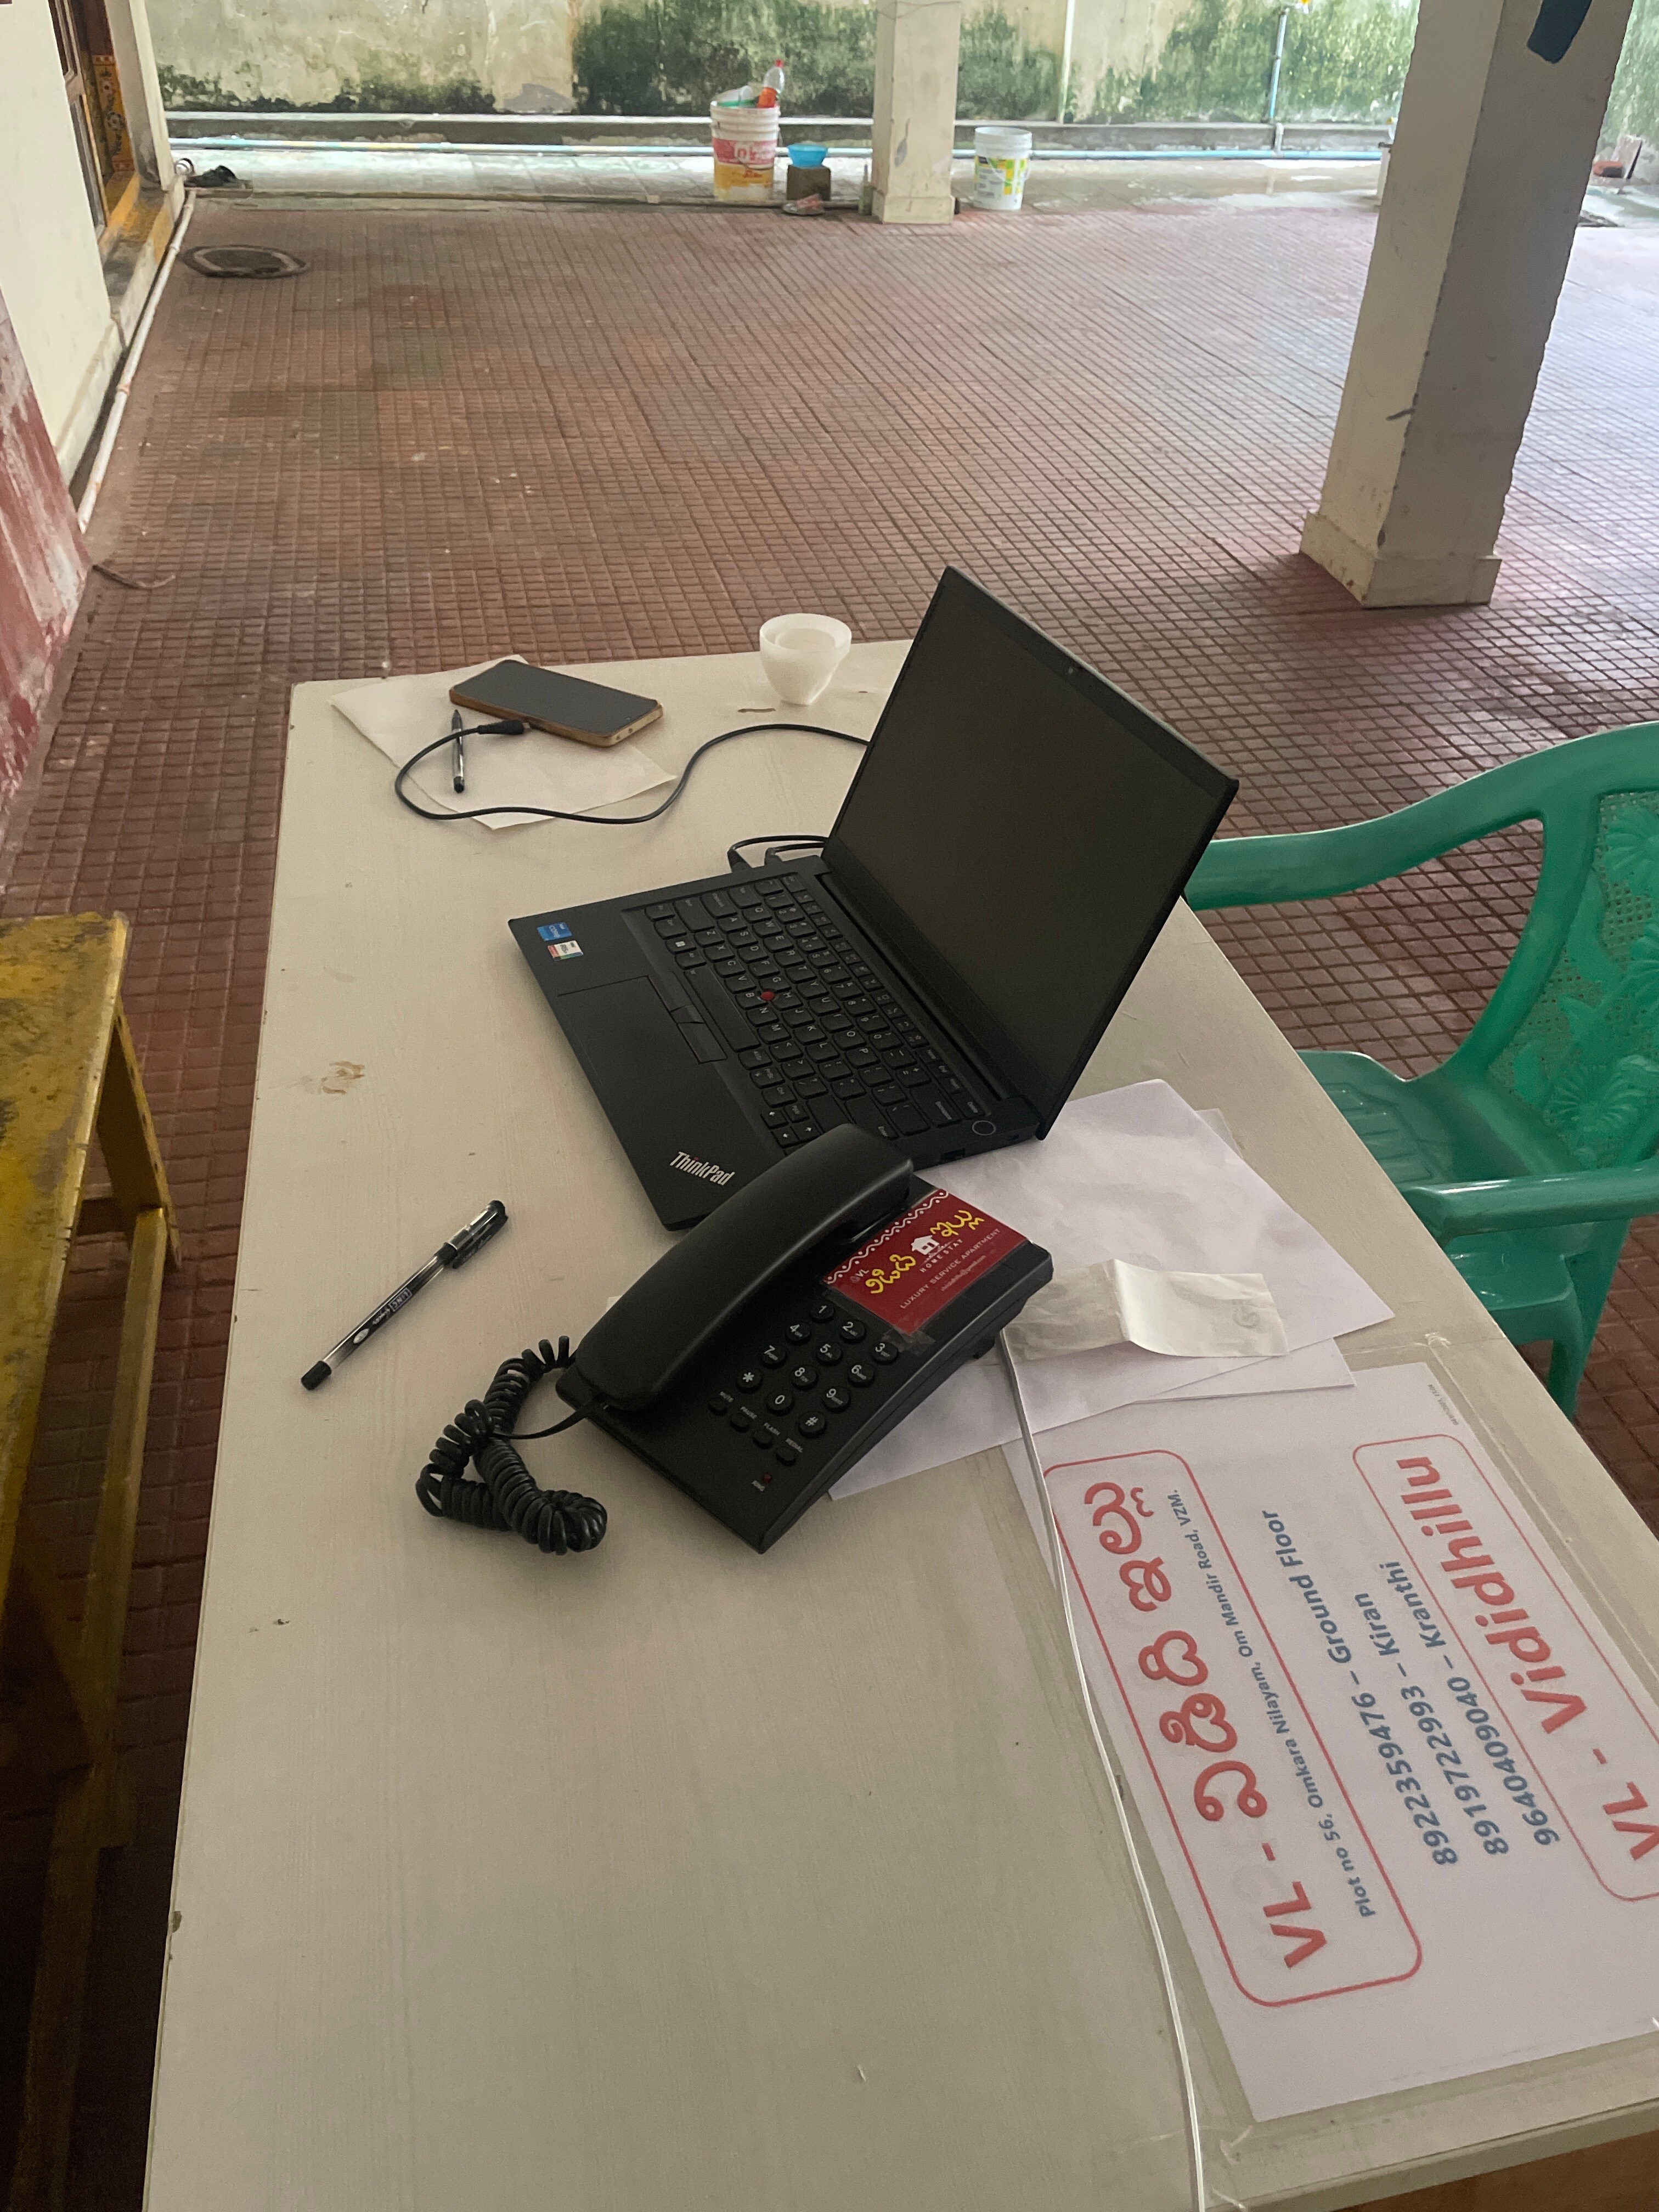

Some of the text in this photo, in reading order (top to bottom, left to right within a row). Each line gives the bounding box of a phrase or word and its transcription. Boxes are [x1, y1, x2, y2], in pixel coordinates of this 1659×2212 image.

[669, 1151, 736, 1186] ThinkPad
[855, 1268, 870, 1278] VL
[865, 1254, 917, 1294] విడిది
[929, 1210, 985, 1237] ఇల్లు
[899, 1283, 930, 1309] LUXURY
[930, 1259, 961, 1284] SERVICE
[960, 1227, 1001, 1260] APARTMENT
[919, 1254, 944, 1273] HOME
[944, 1238, 963, 1255] STAY
[789, 1324, 862, 1374] 4 5 6
[818, 1305, 885, 1352] 1 2 3
[763, 1345, 837, 1398] 7 8 9
[775, 1395, 786, 1404] 0
[1262, 1510, 1304, 1567] Floor
[1288, 1575, 1352, 1663] Ground
[1355, 1593, 1400, 1657] Kiran
[1379, 1561, 1446, 1648] Kranthi
[1396, 1457, 1659, 1861] VL - Vididhillu
[1084, 1482, 1327, 1970] VL - విడిది ఇల్లు
[1167, 1490, 1376, 1917] Plot no 56, Omkara Nilayam, Om Mandir Road, VZM.
[1351, 1692, 1458, 1865] 8922359476
[1401, 1685, 1509, 1855] 8919722993
[1447, 1676, 1560, 1846] 9640409040
